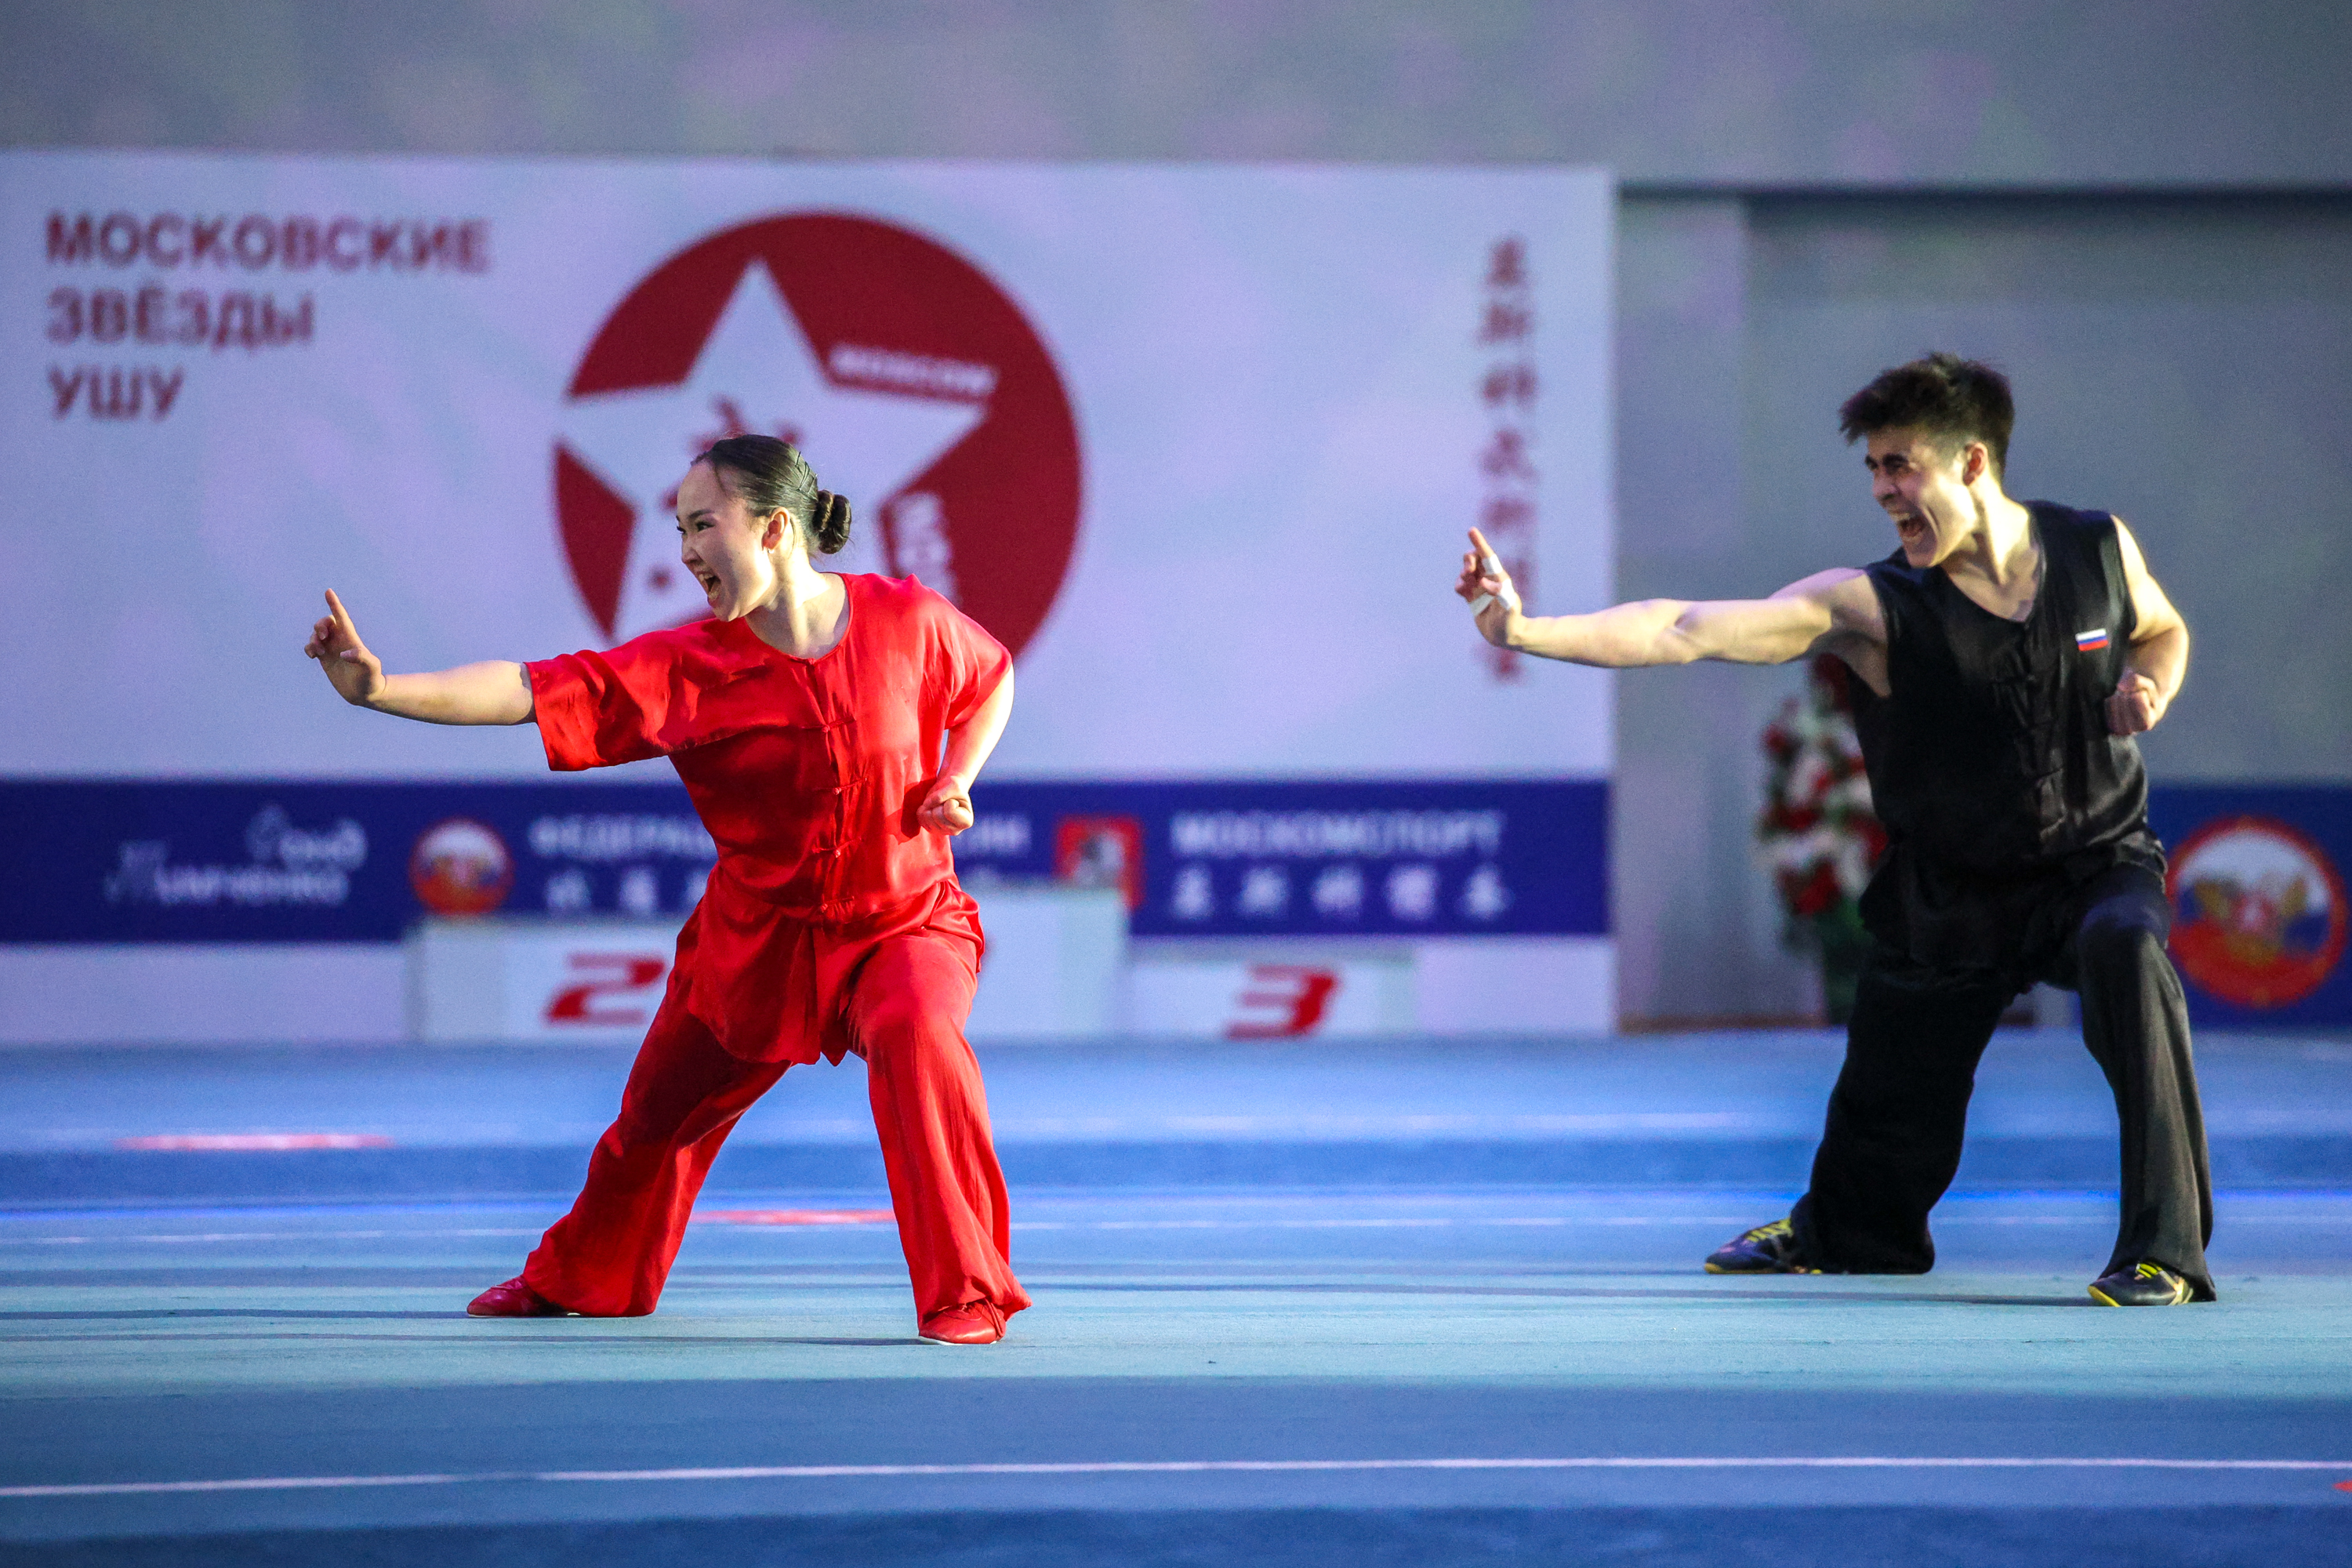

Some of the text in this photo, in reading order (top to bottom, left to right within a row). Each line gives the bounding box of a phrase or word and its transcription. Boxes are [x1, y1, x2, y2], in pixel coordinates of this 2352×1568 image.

[45, 212, 492, 276] МОСКОВСКИЕ
[47, 281, 315, 351] ЗВЁЗДЫ
[49, 365, 185, 422] УШУ
[1170, 811, 1504, 858] МОСКОМСПОРТ
[546, 953, 666, 1025] 2
[1226, 964, 1336, 1039] 3
